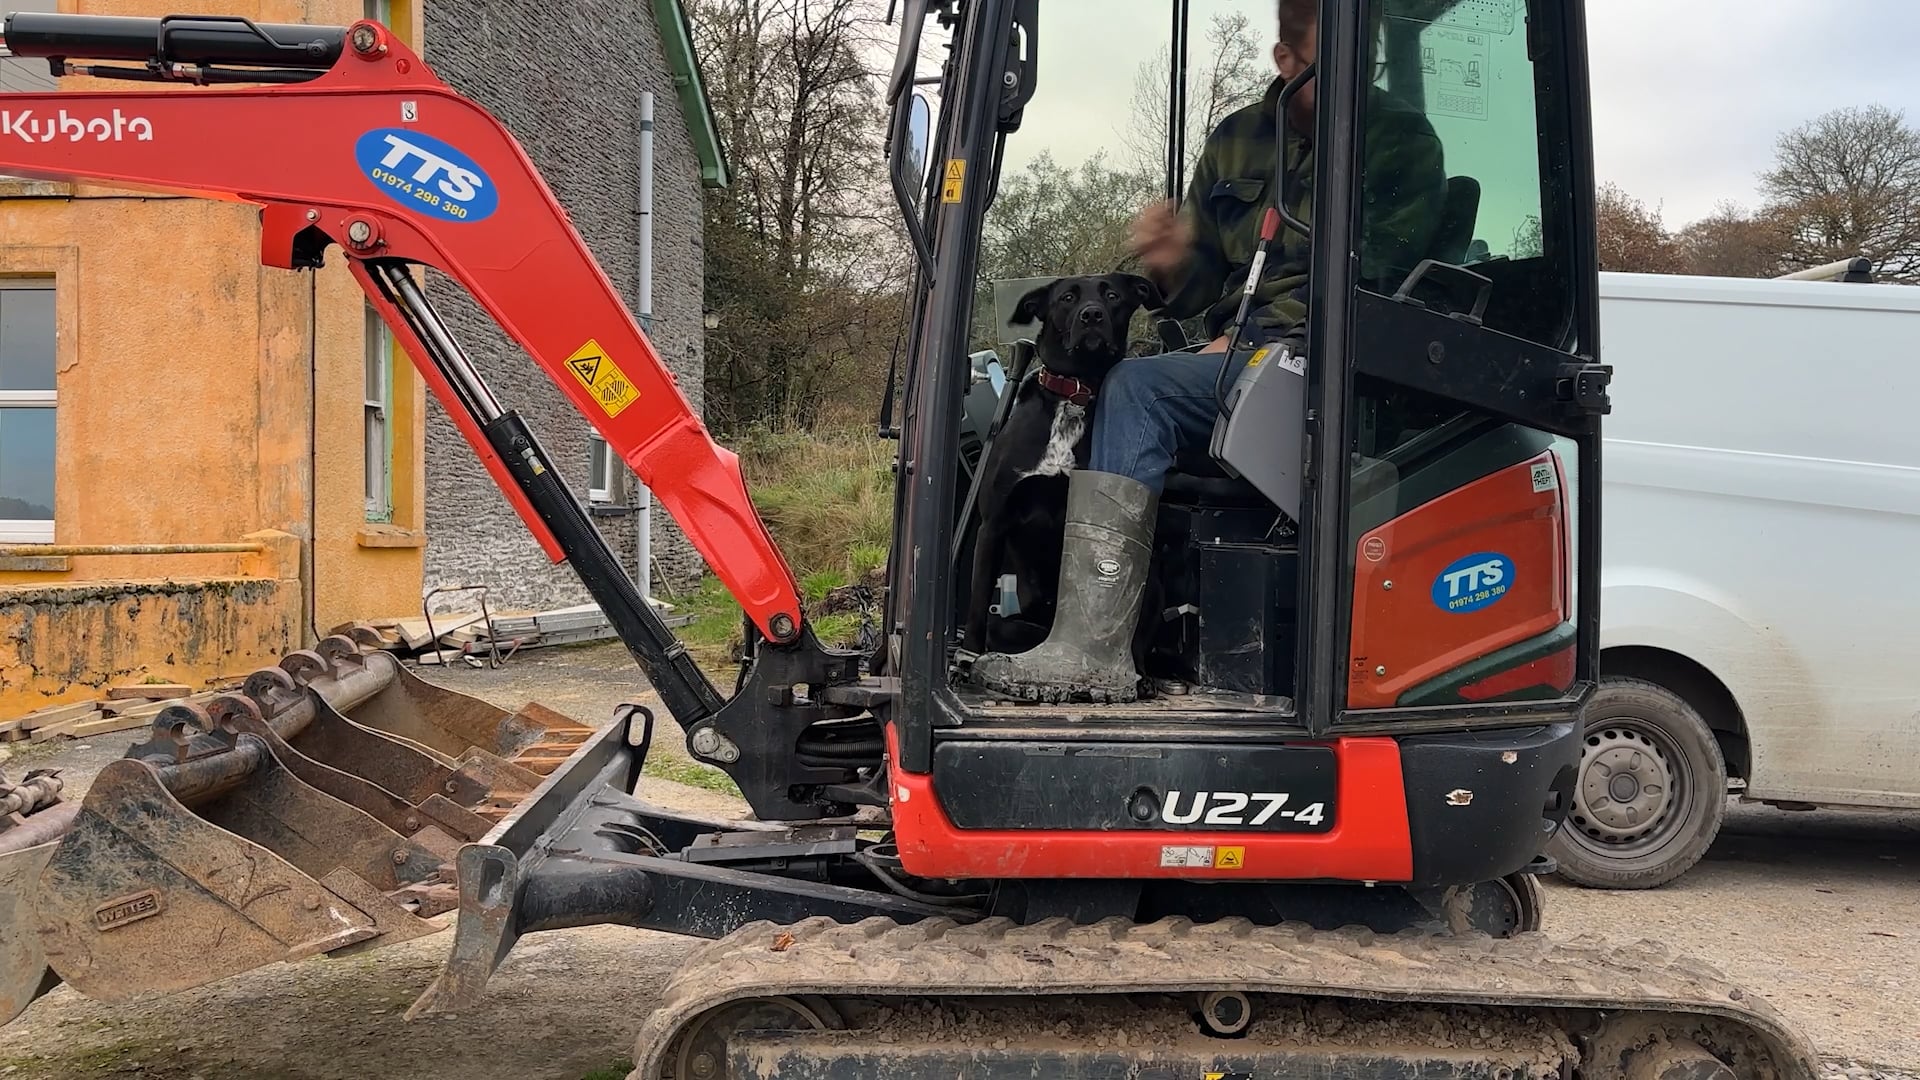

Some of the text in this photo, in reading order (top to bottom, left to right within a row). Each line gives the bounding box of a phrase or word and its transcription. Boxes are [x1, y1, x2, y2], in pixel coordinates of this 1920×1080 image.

[1, 108, 153, 143] Kubota
[380, 134, 483, 202] TTS
[372, 168, 467, 219] 01974 298 380
[1443, 559, 1504, 598] TTS
[1449, 585, 1505, 609] 01974 298 380
[1161, 790, 1325, 826] U27-4
